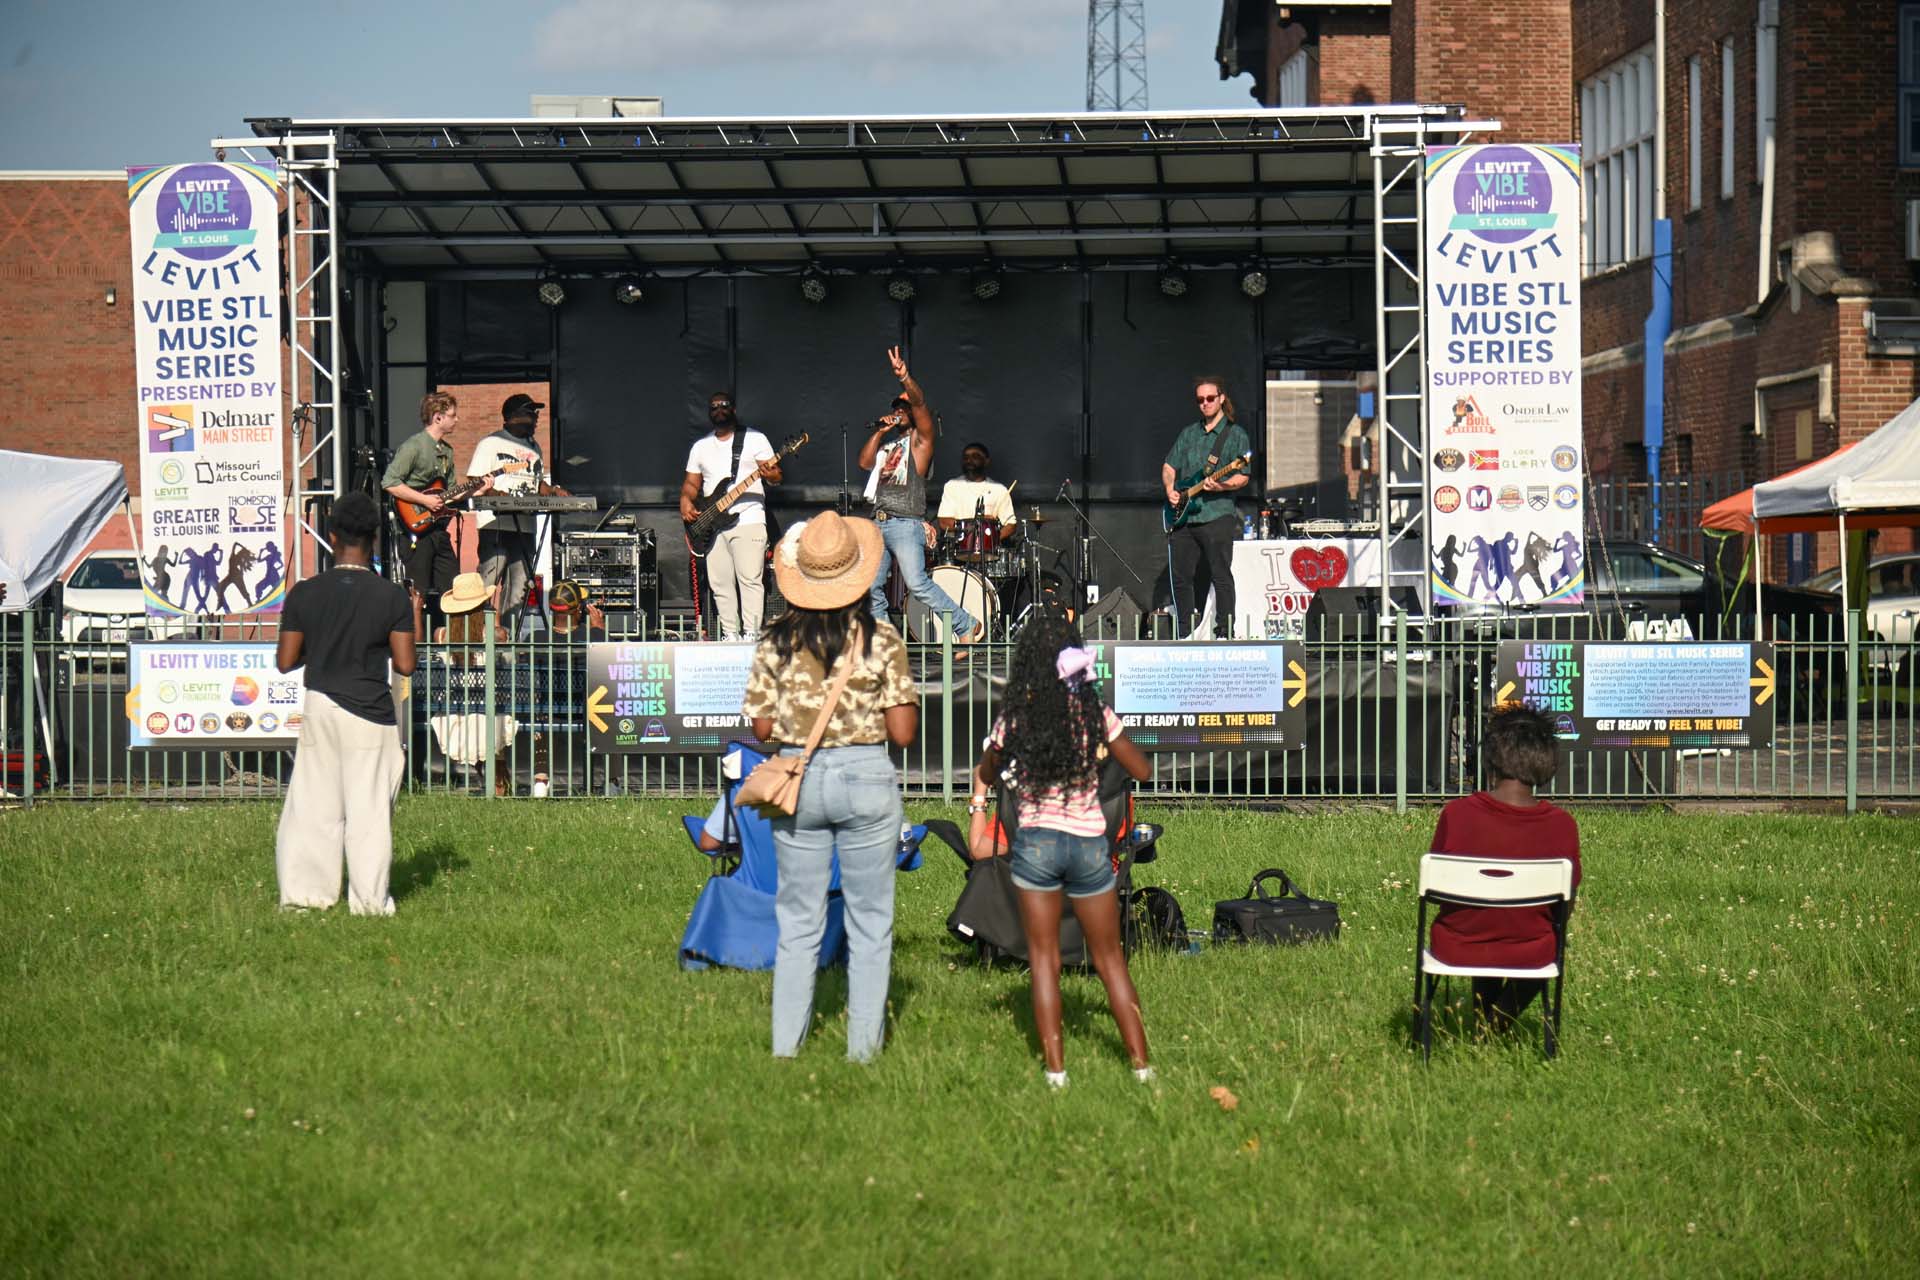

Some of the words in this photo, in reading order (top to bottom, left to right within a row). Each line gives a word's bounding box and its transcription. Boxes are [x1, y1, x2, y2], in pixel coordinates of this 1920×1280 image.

[1475, 162, 1531, 174] LEVITT
[176, 179, 230, 193] LEVITT
[1476, 173, 1529, 196] VIBE
[178, 192, 229, 214] VIBE
[1479, 218, 1494, 226] ST.
[1497, 218, 1527, 226] LOUIS
[1437, 232, 1562, 274] LEVITT
[142, 249, 262, 291] LEVITT
[1436, 283, 1507, 306] VIBE
[1518, 282, 1571, 306] STL
[143, 298, 212, 323] VIBE
[223, 296, 272, 320] STL
[1451, 311, 1557, 335] MUSIC
[158, 324, 258, 351] MUSIC
[1448, 340, 1553, 364] SERIES
[156, 353, 255, 380] SERIES
[1434, 371, 1544, 386] SUPPORTED
[1550, 371, 1573, 384] BY
[141, 383, 245, 401] PRESENTED
[251, 382, 276, 397] BY
[1503, 403, 1544, 415] ONDER
[202, 410, 274, 428] Delmar
[203, 429, 229, 444] MAIN
[232, 428, 273, 442] STREET
[216, 461, 260, 471] Missouri
[216, 473, 237, 482] Arts
[240, 471, 281, 480] Council
[154, 488, 188, 496] LEVITT
[154, 508, 219, 524] GREATER
[154, 527, 169, 536] ST.
[172, 526, 203, 536] LOUIS
[205, 524, 221, 534] INC.
[1261, 548, 1289, 591] I
[616, 647, 664, 662] LEVITT
[1524, 644, 1573, 660] LEVITT
[1657, 647, 1672, 659] STL
[1677, 647, 1706, 658] MUSIC
[1710, 646, 1744, 658] SERIES
[151, 654, 198, 668] LEVITT
[203, 654, 238, 668] VIBE
[244, 654, 267, 668] STL
[608, 665, 643, 680] VIBE
[648, 664, 672, 679] STL
[1096, 663, 1112, 678] TL
[1517, 662, 1551, 677] VIBE
[1555, 662, 1579, 677] STL
[183, 683, 222, 692] LEVITT
[618, 683, 663, 698] MUSIC
[1525, 679, 1570, 694] MUSIC
[615, 700, 666, 716] SERIES
[683, 717, 702, 728] GET
[706, 716, 740, 727] READY
[1123, 715, 1142, 726] GET
[1144, 715, 1180, 726] READY
[1183, 715, 1195, 726] TO
[1199, 714, 1222, 726] FEEL
[1225, 714, 1245, 726] THE
[1247, 714, 1275, 725] VIBE!
[1596, 720, 1614, 731] GET
[1618, 720, 1651, 731] READY
[1654, 720, 1667, 731] TO
[1669, 720, 1691, 731] FEEL
[1694, 720, 1713, 731] THE
[1715, 720, 1742, 731] VIBE!
